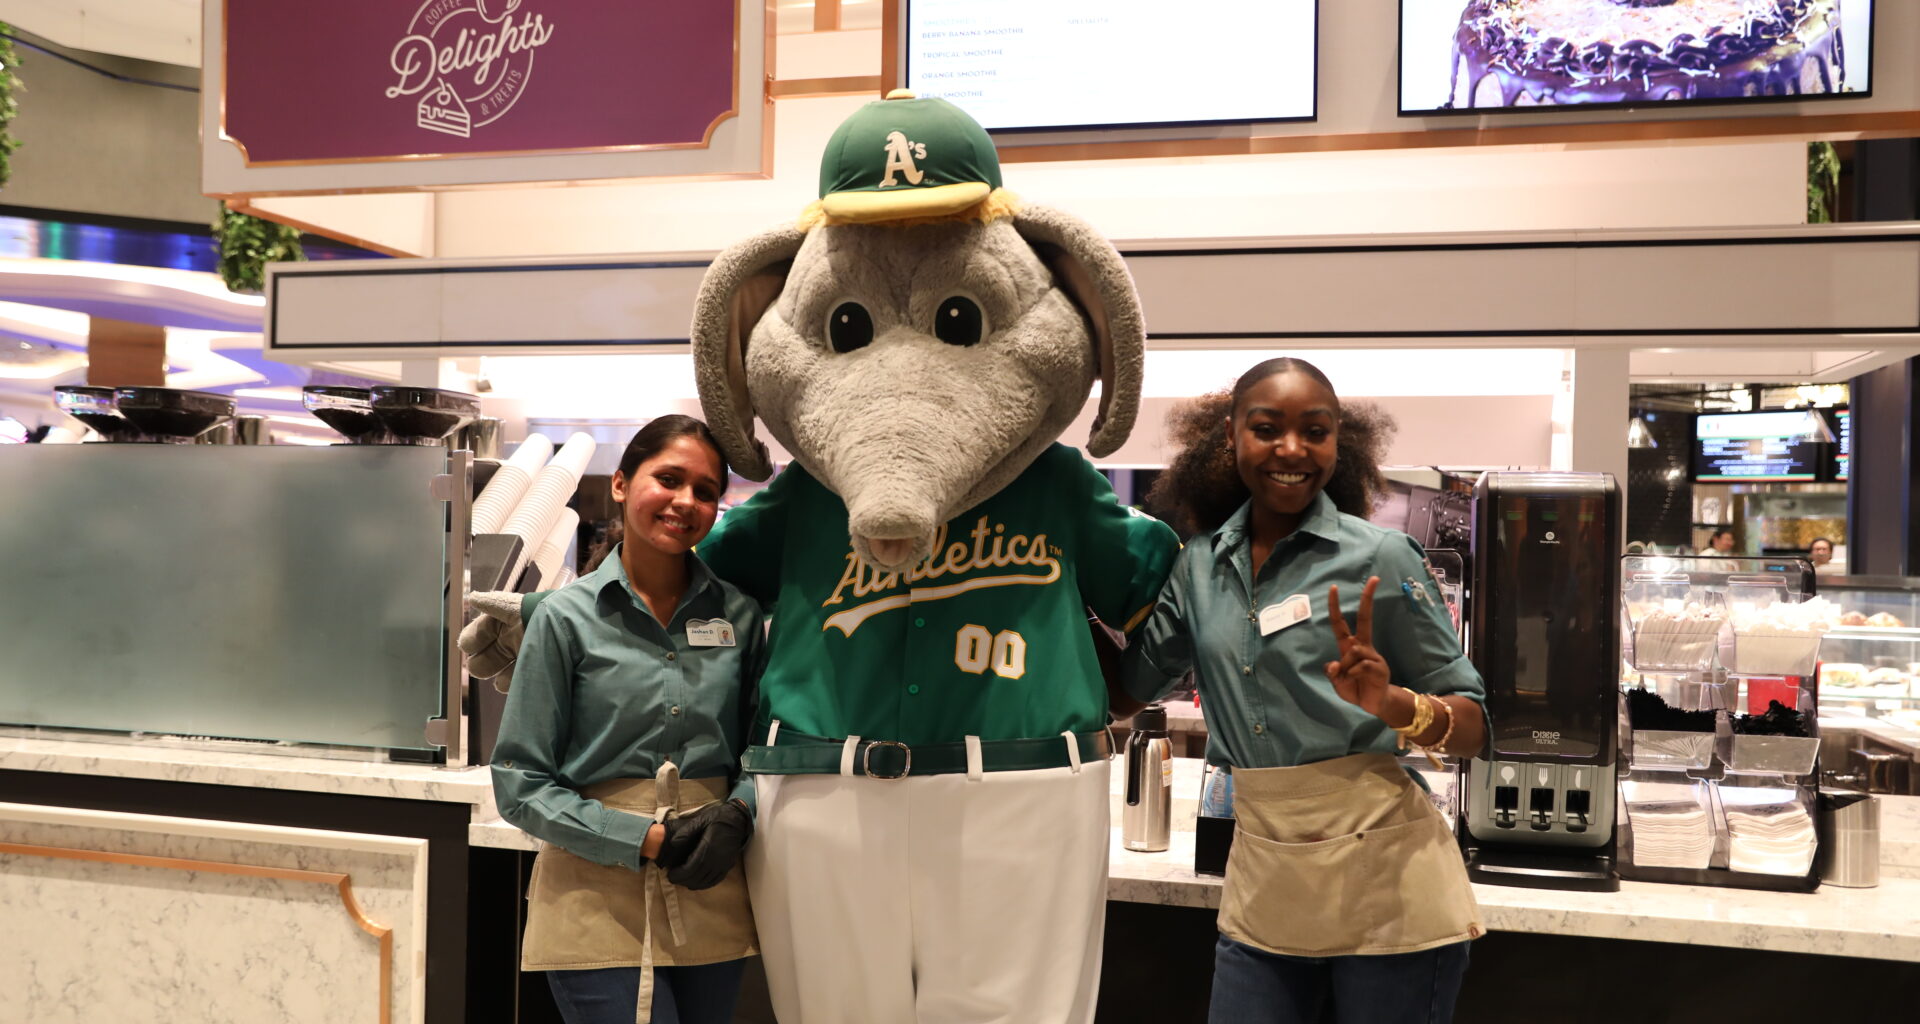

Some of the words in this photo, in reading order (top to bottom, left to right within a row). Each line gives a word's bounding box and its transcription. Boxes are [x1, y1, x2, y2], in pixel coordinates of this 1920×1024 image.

[949, 30, 981, 38] BANANA
[984, 27, 1024, 36] SMOOTHIE
[385, 11, 554, 98] Delights
[963, 49, 1004, 57] SMOOTHIE
[957, 70, 997, 78] SMOOTHIE
[480, 103, 490, 116] &
[489, 69, 523, 108] TREATS
[943, 90, 984, 98] SMOOTHIE
[822, 515, 1047, 607] Aletics
[954, 623, 1027, 680] 00
